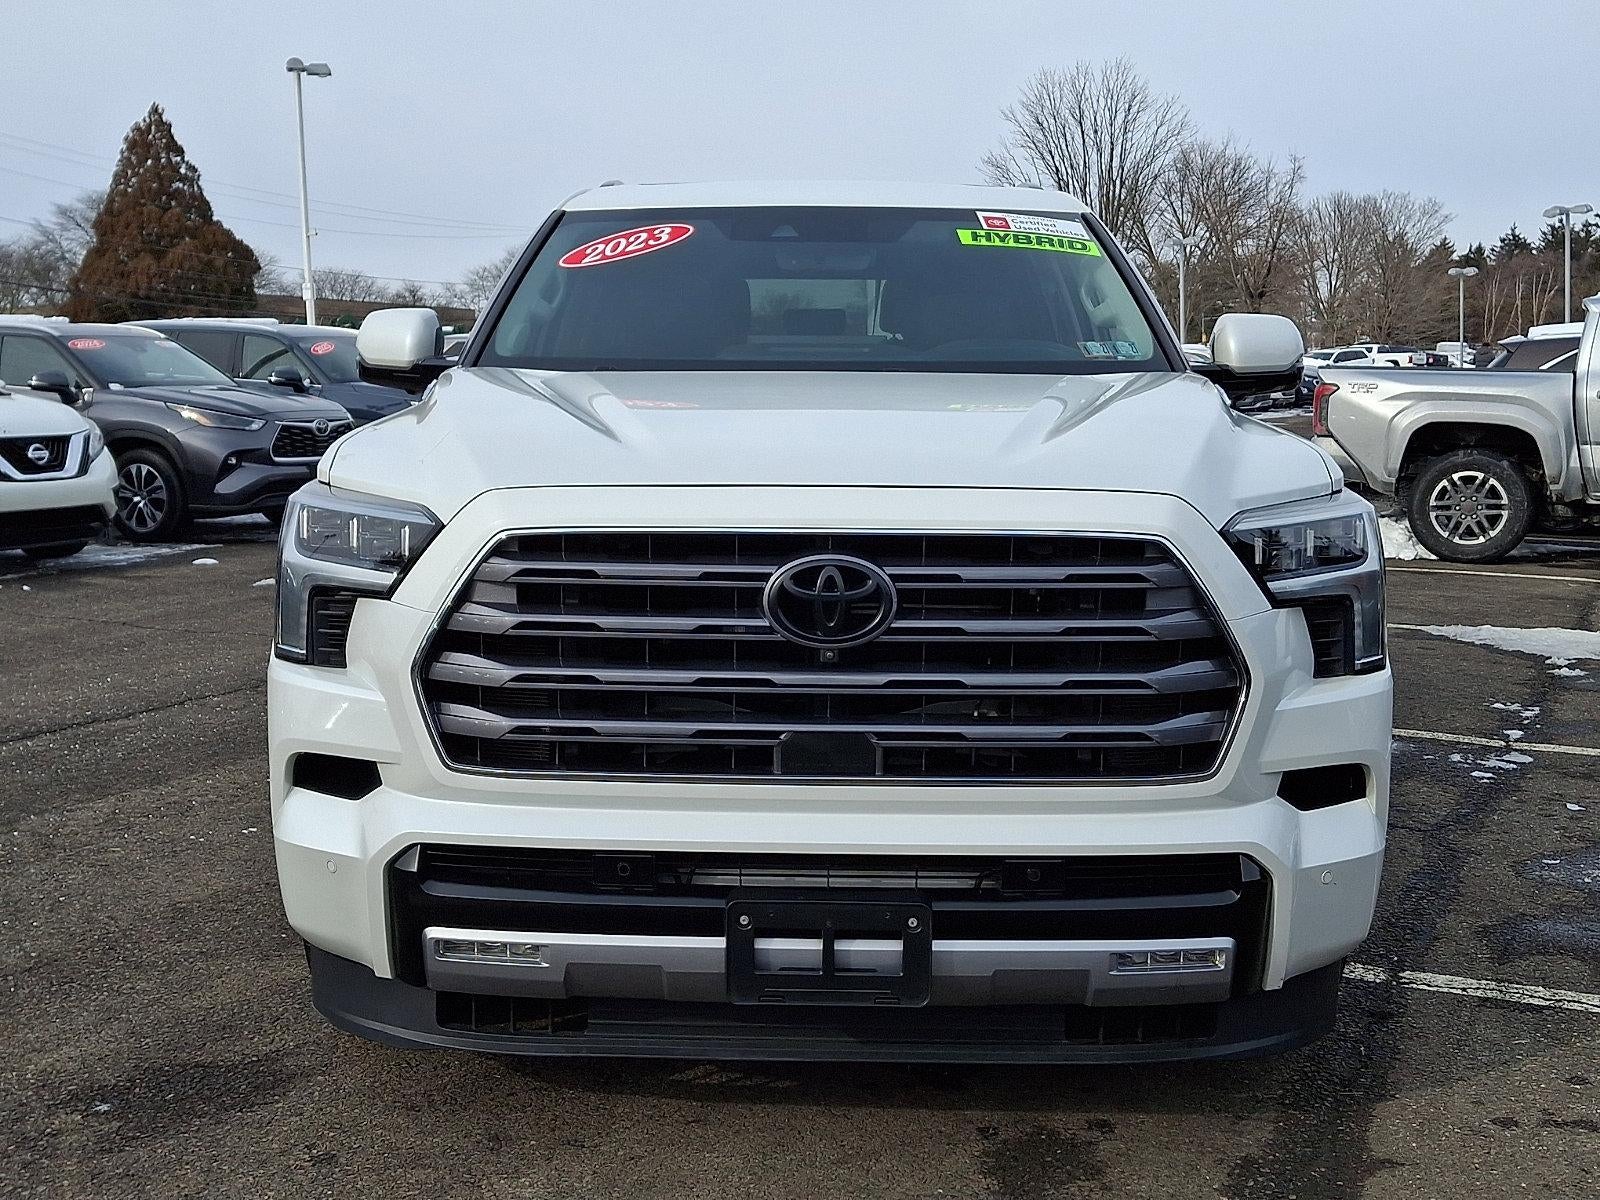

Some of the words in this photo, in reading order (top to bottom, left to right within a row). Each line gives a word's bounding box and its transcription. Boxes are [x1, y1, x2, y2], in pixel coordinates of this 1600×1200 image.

[1011, 218, 1057, 229] Certified
[1013, 224, 1041, 232] Used
[1041, 227, 1085, 238] Vehicles
[581, 226, 673, 264] 2023
[971, 230, 1092, 253] HYBRID
